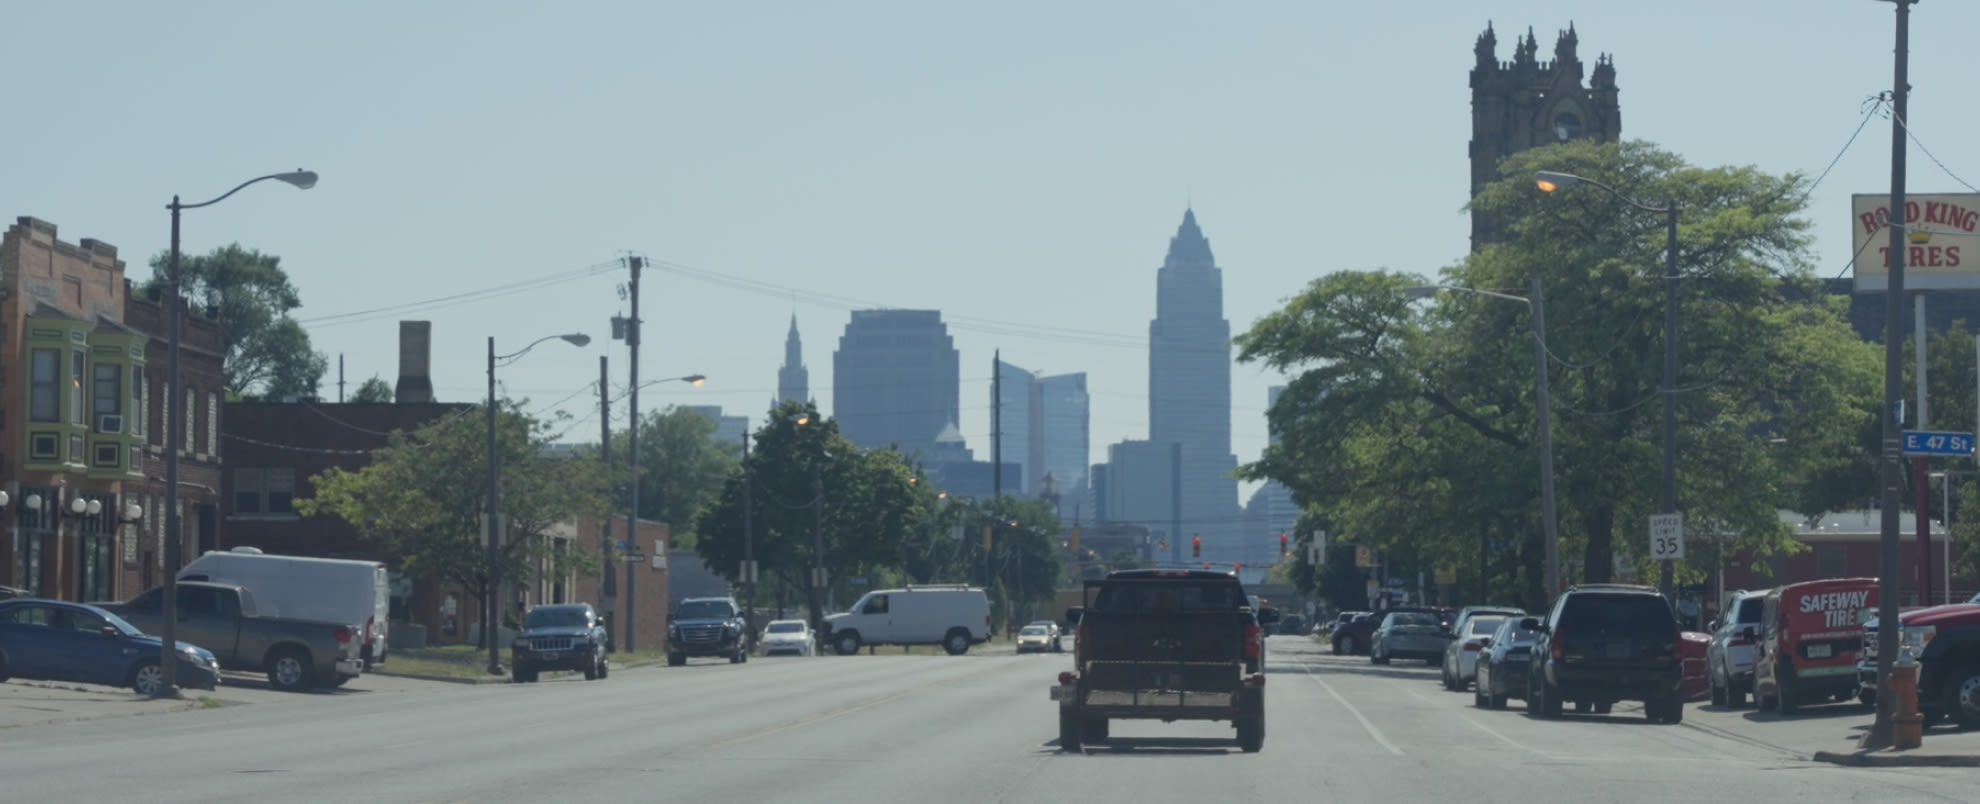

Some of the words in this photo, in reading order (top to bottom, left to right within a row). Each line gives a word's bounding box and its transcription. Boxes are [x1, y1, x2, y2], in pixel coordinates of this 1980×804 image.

[1859, 201, 1920, 235] ROD
[1924, 201, 1979, 233] KING
[1879, 246, 1960, 268] TRES
[1926, 436, 1945, 449] 47
[1951, 436, 1968, 450] St
[1653, 518, 1679, 526] SPEED
[1655, 527, 1676, 536] LIMIT
[1656, 537, 1678, 555] 35
[1800, 591, 1869, 613] SAFEWAY
[1825, 609, 1855, 628] TIRE
